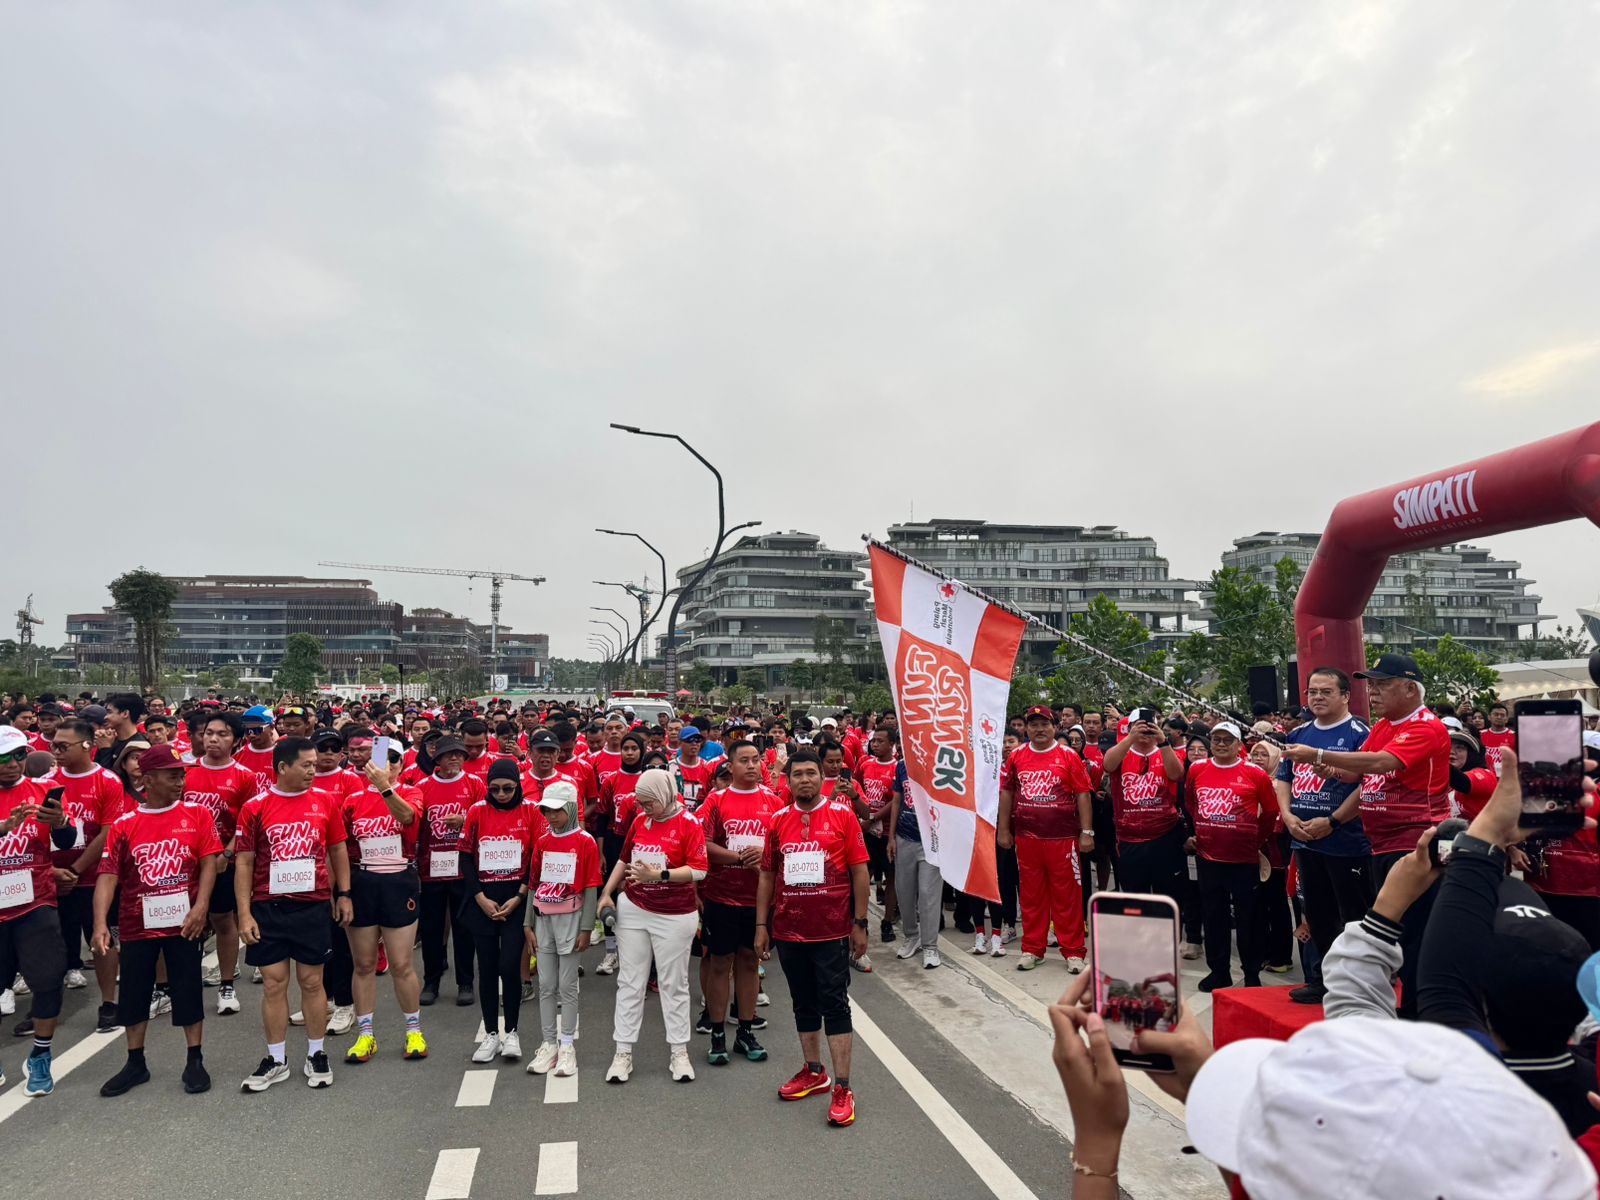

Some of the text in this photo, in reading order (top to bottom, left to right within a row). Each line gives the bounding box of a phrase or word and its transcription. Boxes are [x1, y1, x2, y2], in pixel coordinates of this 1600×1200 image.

[1393, 469, 1478, 529] SIMPATI
[1017, 770, 1052, 785] FUN
[1122, 771, 1155, 788] FUN
[1291, 773, 1326, 798] RUN
[1021, 783, 1054, 800] RUN
[1123, 784, 1158, 805] RUN
[1196, 786, 1232, 802] FUN
[1319, 792, 1330, 800] 5K
[1374, 792, 1386, 801] 5K
[427, 802, 461, 821] FUN
[1198, 801, 1233, 819] RUN
[266, 821, 310, 845] FUN
[352, 815, 392, 836] FUN
[723, 818, 761, 838] FUN
[0, 836, 28, 859] UN
[131, 838, 179, 865] FUN
[270, 839, 313, 862] RUN
[484, 850, 517, 860] P80-0301
[138, 857, 183, 886] RUN
[0, 883, 26, 896] -0893
[148, 904, 185, 918] L80-0841
